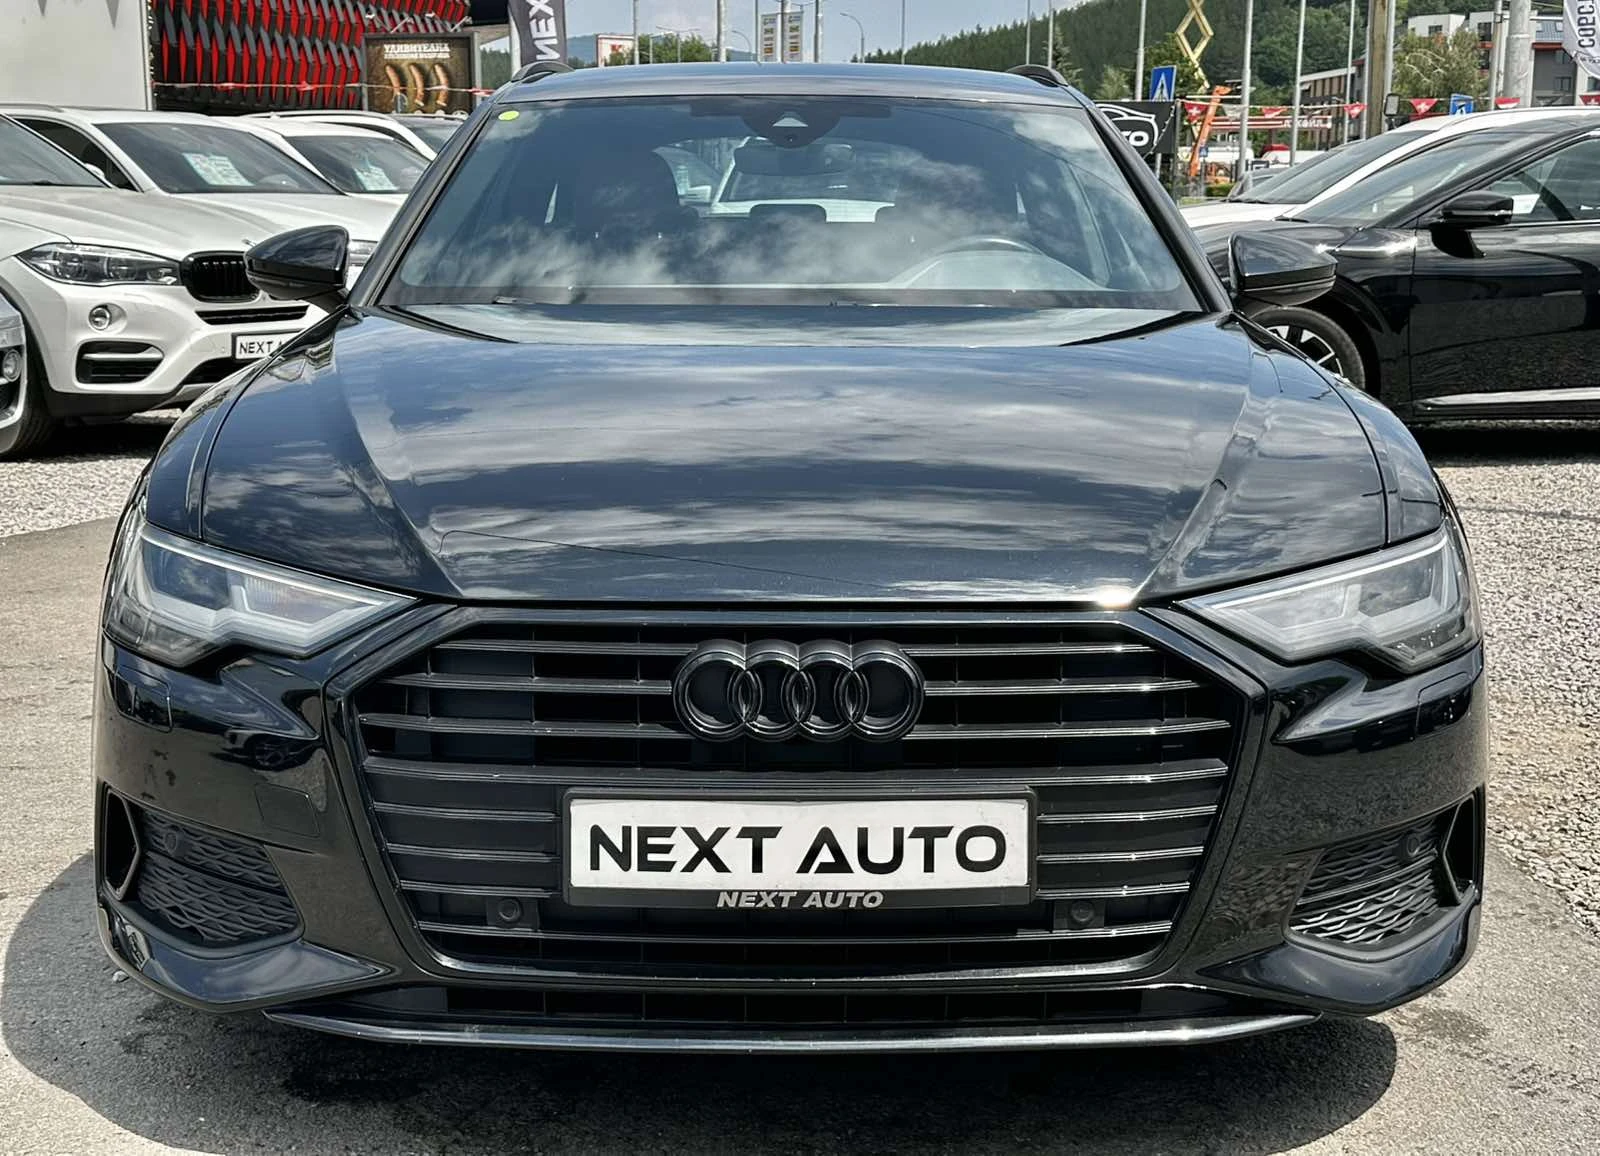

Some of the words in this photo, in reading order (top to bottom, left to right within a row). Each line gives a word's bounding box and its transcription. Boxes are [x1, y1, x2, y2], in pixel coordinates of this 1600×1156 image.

[240, 341, 273, 353] NEXT
[590, 825, 782, 873] NEXT
[796, 825, 1006, 875] AUTO
[717, 891, 797, 908] NEXT
[802, 891, 884, 908] AUTO
